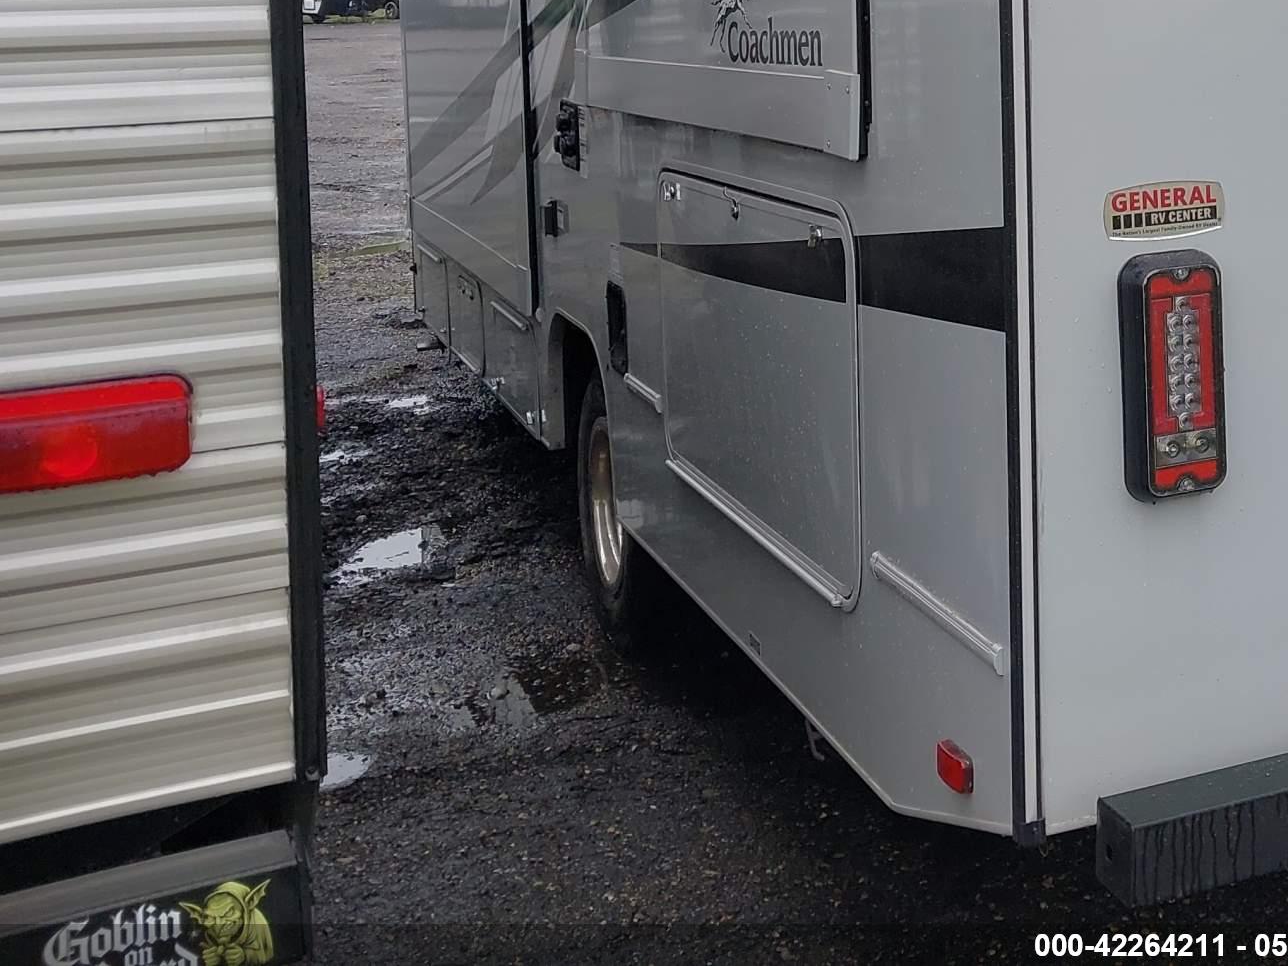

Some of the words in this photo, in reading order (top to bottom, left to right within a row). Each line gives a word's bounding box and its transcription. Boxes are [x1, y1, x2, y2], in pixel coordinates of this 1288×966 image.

[727, 16, 823, 67] Coachmen
[1111, 184, 1217, 213] GENERAL
[1150, 212, 1166, 226] RV
[1168, 207, 1212, 223] CENTER
[43, 903, 183, 966] Goblin
[124, 946, 154, 966] on
